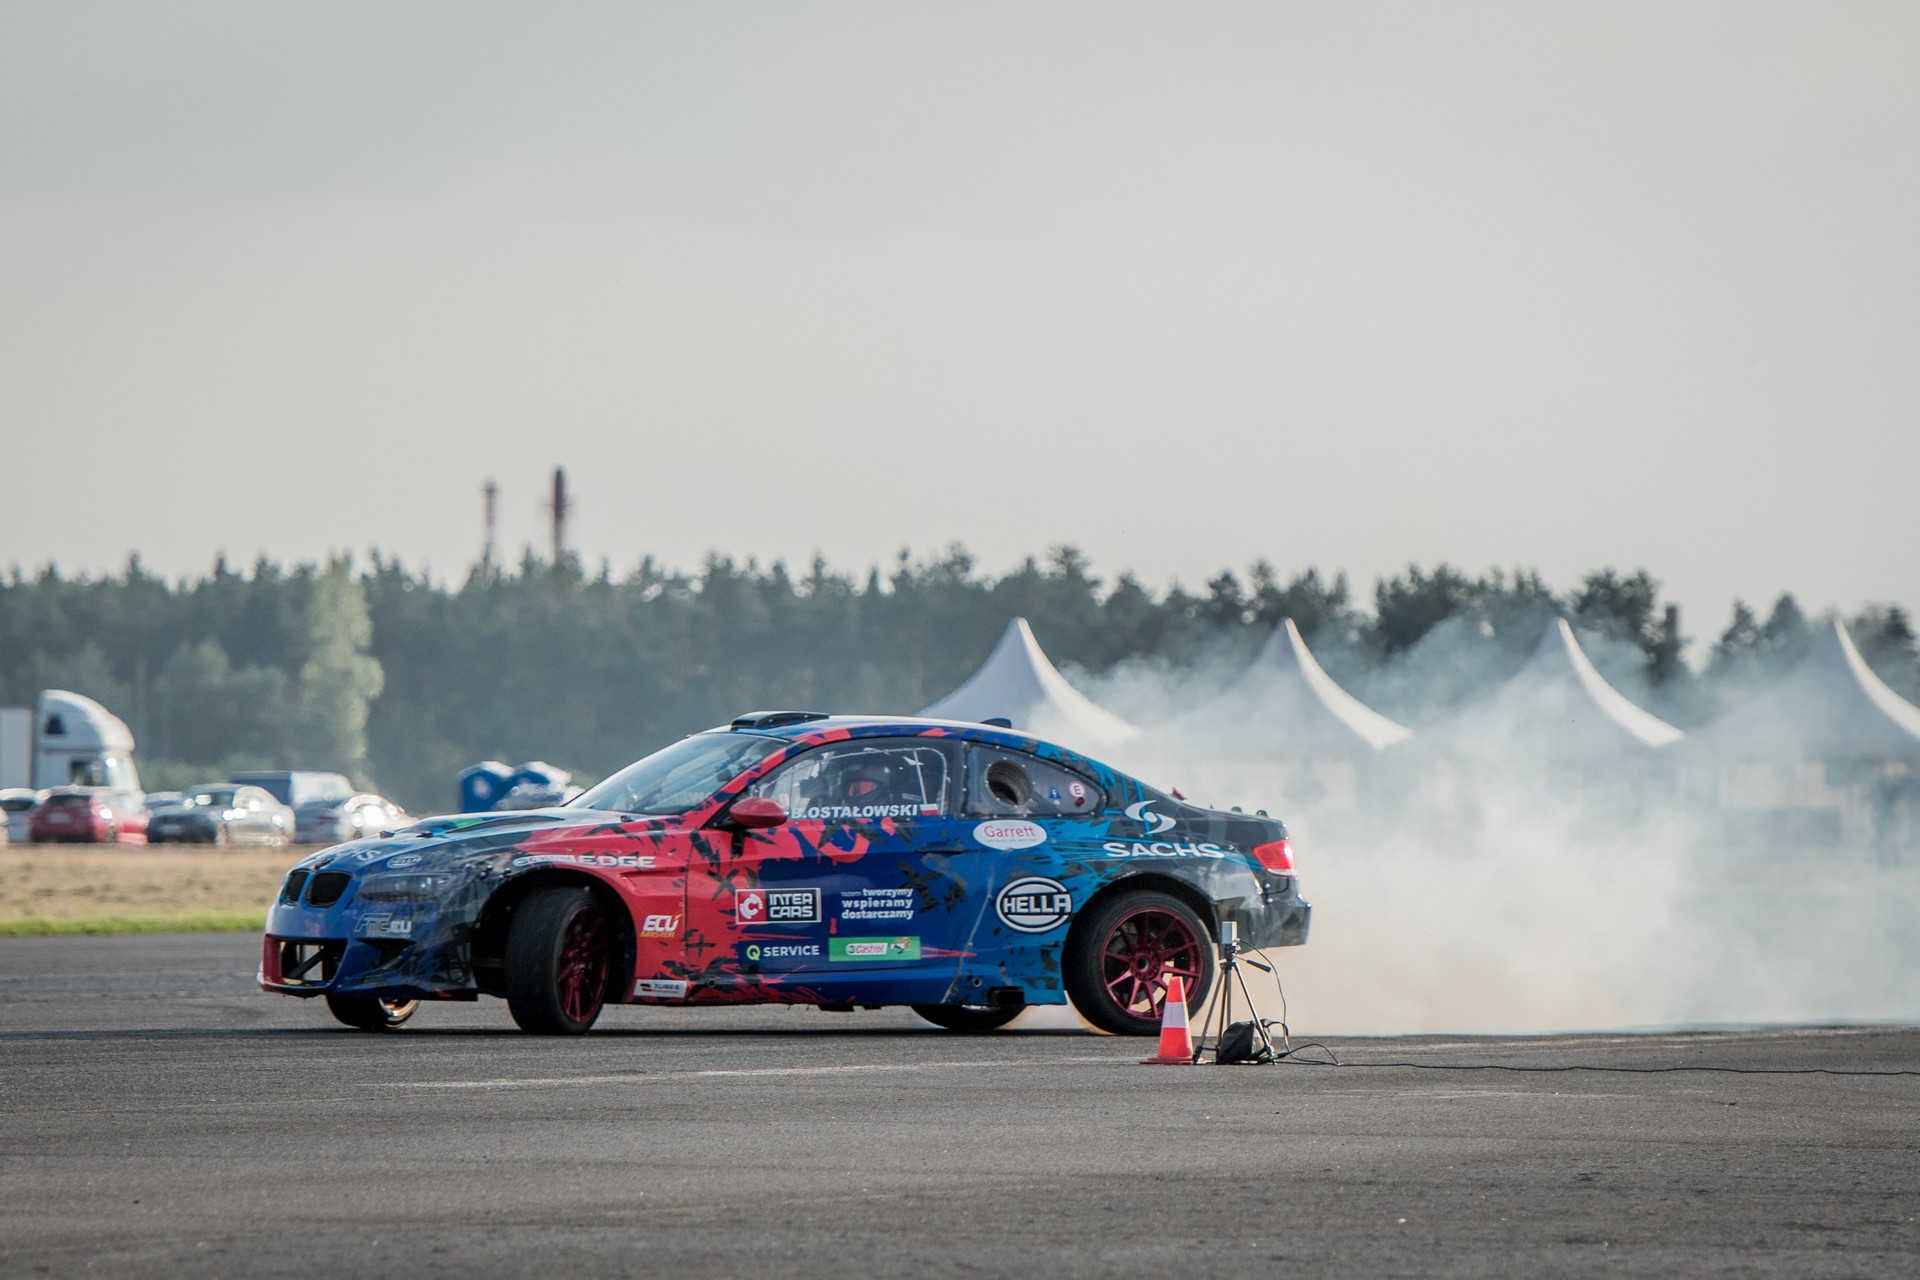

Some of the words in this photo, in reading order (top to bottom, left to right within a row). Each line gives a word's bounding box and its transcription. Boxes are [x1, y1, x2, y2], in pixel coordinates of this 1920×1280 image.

[984, 825, 1036, 838] Garrett
[1103, 842, 1225, 859] SACHS
[577, 855, 656, 868] EDGE
[863, 888, 913, 897] tworzymy
[769, 893, 813, 905] INTER
[842, 898, 913, 909] wspieramy
[1003, 894, 1071, 913] HELLA
[770, 906, 813, 918] CARS
[842, 909, 914, 920] dostarczamy
[643, 914, 681, 931] ECU
[764, 945, 819, 956] SERVICE
[856, 944, 884, 955] Castrol
